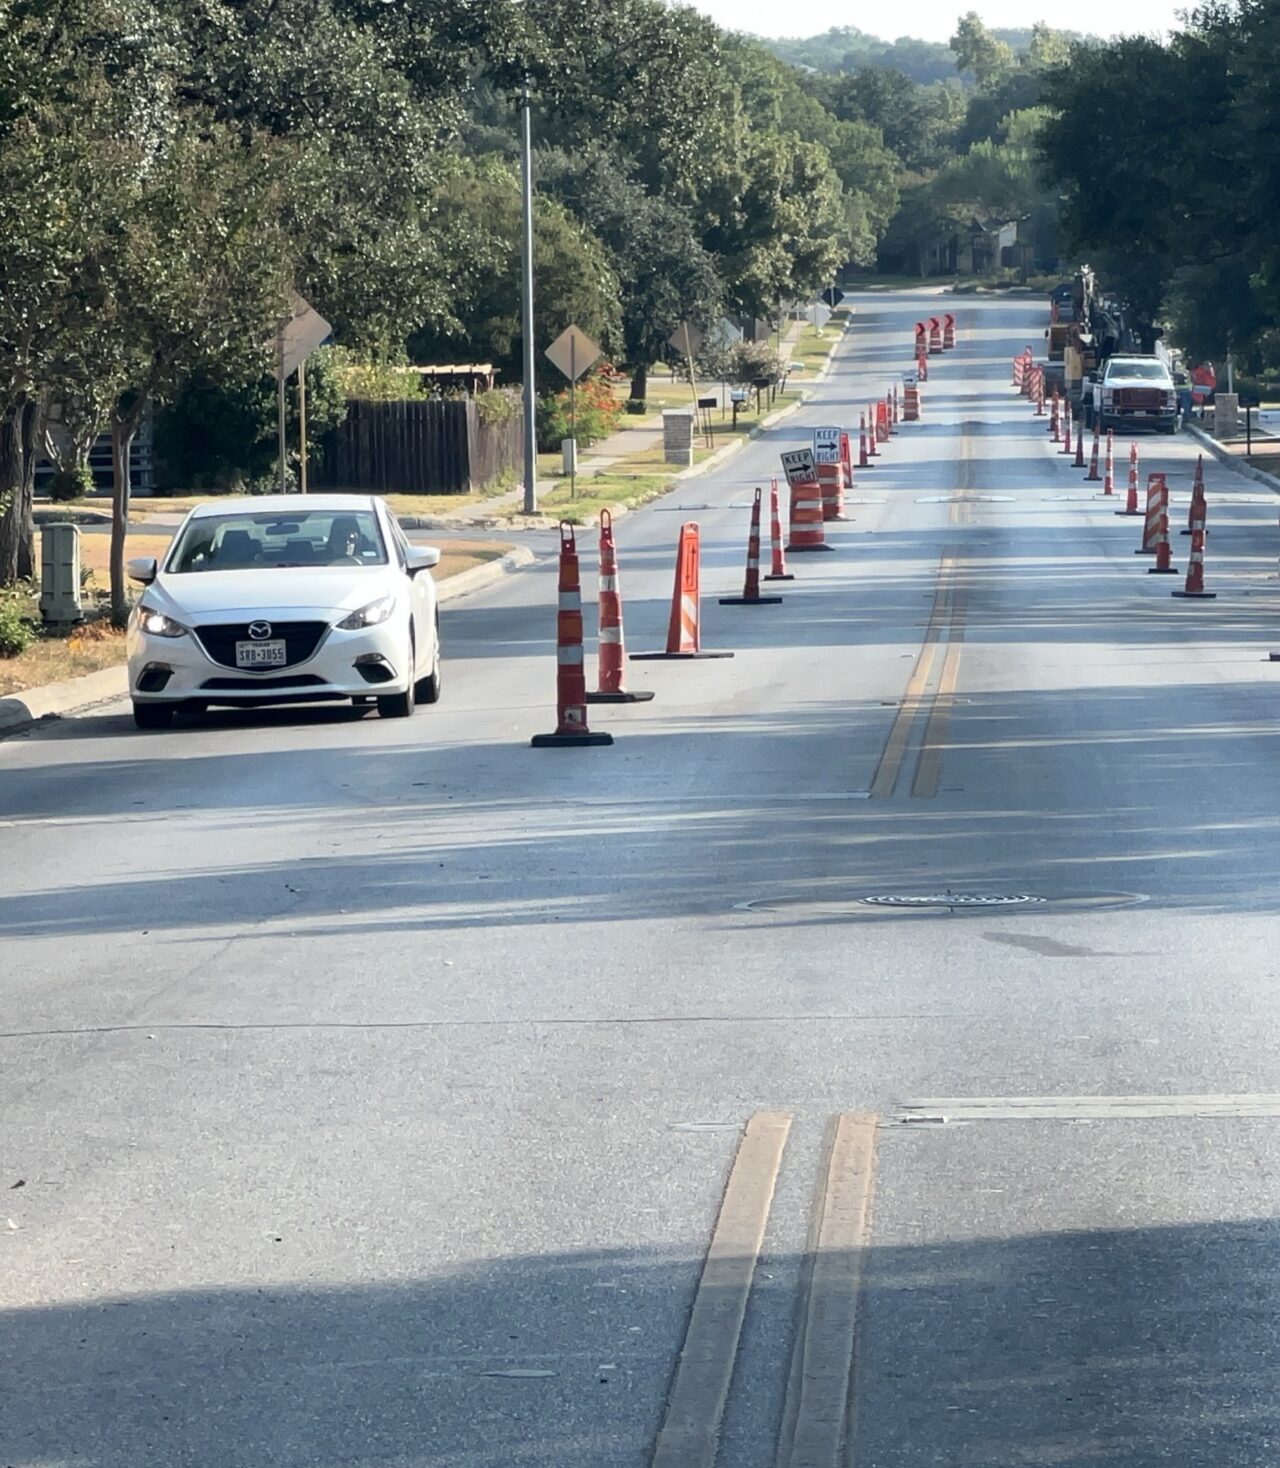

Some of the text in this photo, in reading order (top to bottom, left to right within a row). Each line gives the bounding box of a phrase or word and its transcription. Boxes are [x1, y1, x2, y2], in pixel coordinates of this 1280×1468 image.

[816, 430, 838, 440] KEEP
[784, 452, 809, 465] KEEP
[816, 451, 839, 461] RIGHT
[789, 471, 816, 483] RIGHT
